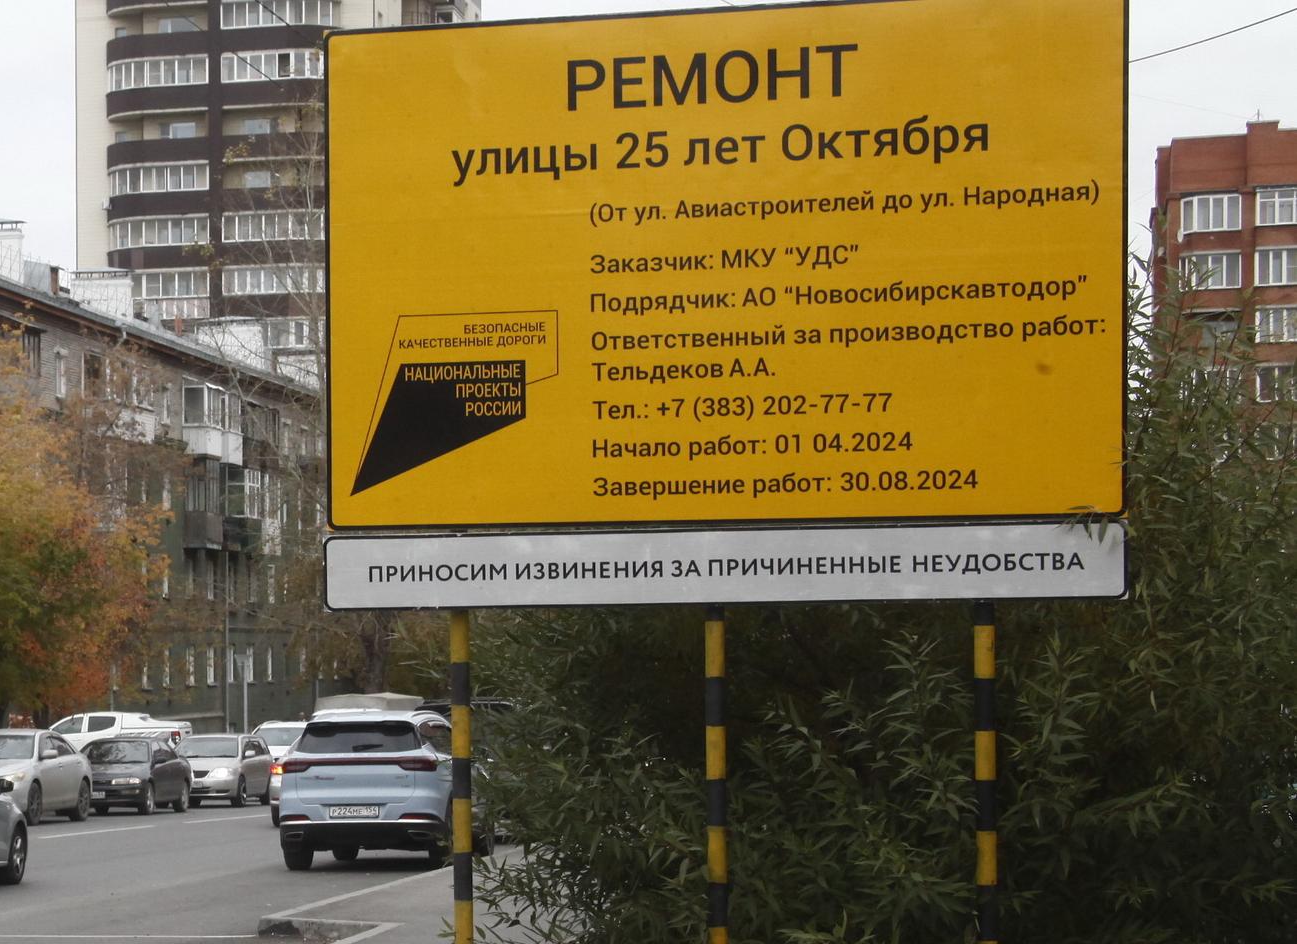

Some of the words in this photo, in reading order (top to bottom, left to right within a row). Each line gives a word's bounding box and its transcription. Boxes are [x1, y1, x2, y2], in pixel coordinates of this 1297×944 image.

[566, 43, 859, 112] РЕМОНТ
[451, 143, 598, 188] улицы
[615, 130, 669, 170] 25
[683, 135, 766, 167] лет
[781, 114, 989, 165] Октября
[589, 202, 628, 228] (От
[634, 205, 666, 226] ул.
[674, 190, 874, 221] Авиастроителей
[881, 194, 913, 214] до
[920, 192, 954, 211] ул.
[963, 179, 1100, 210] Народная)
[590, 254, 714, 274] Заказчик:
[721, 247, 777, 269] МКУ
[590, 292, 736, 316] Подрядчик:
[741, 286, 776, 307] АО
[398, 336, 494, 350] КАЧЕСТВЕННЫЕ
[496, 334, 546, 348] ДОРОГИ
[463, 321, 546, 335] БЕЗОПАСНЫЕ
[591, 325, 785, 351] Ответственный
[793, 328, 822, 345] за
[829, 322, 1014, 348] производство
[1022, 314, 1106, 342] работ:
[404, 363, 521, 385] НАЦИОНАЛЬНЫЕ
[591, 362, 724, 385] Тельдеков
[729, 357, 776, 378] А.А.
[455, 381, 521, 399] ПРОЕКТЫ
[465, 400, 522, 417] РОССИИ
[592, 400, 649, 420] Тел.:
[656, 398, 685, 418] +7
[693, 394, 754, 423] (383)
[762, 392, 893, 416] 202-77-77
[592, 438, 681, 458] Начало
[688, 434, 767, 461] работ:
[775, 433, 800, 455] 01
[813, 431, 913, 454] 04.2024
[593, 477, 745, 501] Завершение
[752, 472, 832, 499] работ:
[840, 469, 979, 492] 30.08.2024
[368, 563, 507, 583] ПРИНОСИМ
[515, 560, 664, 580] ИЗВИНЕНИЯ
[671, 559, 702, 578] ЗА
[708, 555, 902, 577] ПРИЧИНЕННЫЕ
[912, 552, 1085, 575] НЕУДОБСТВА
